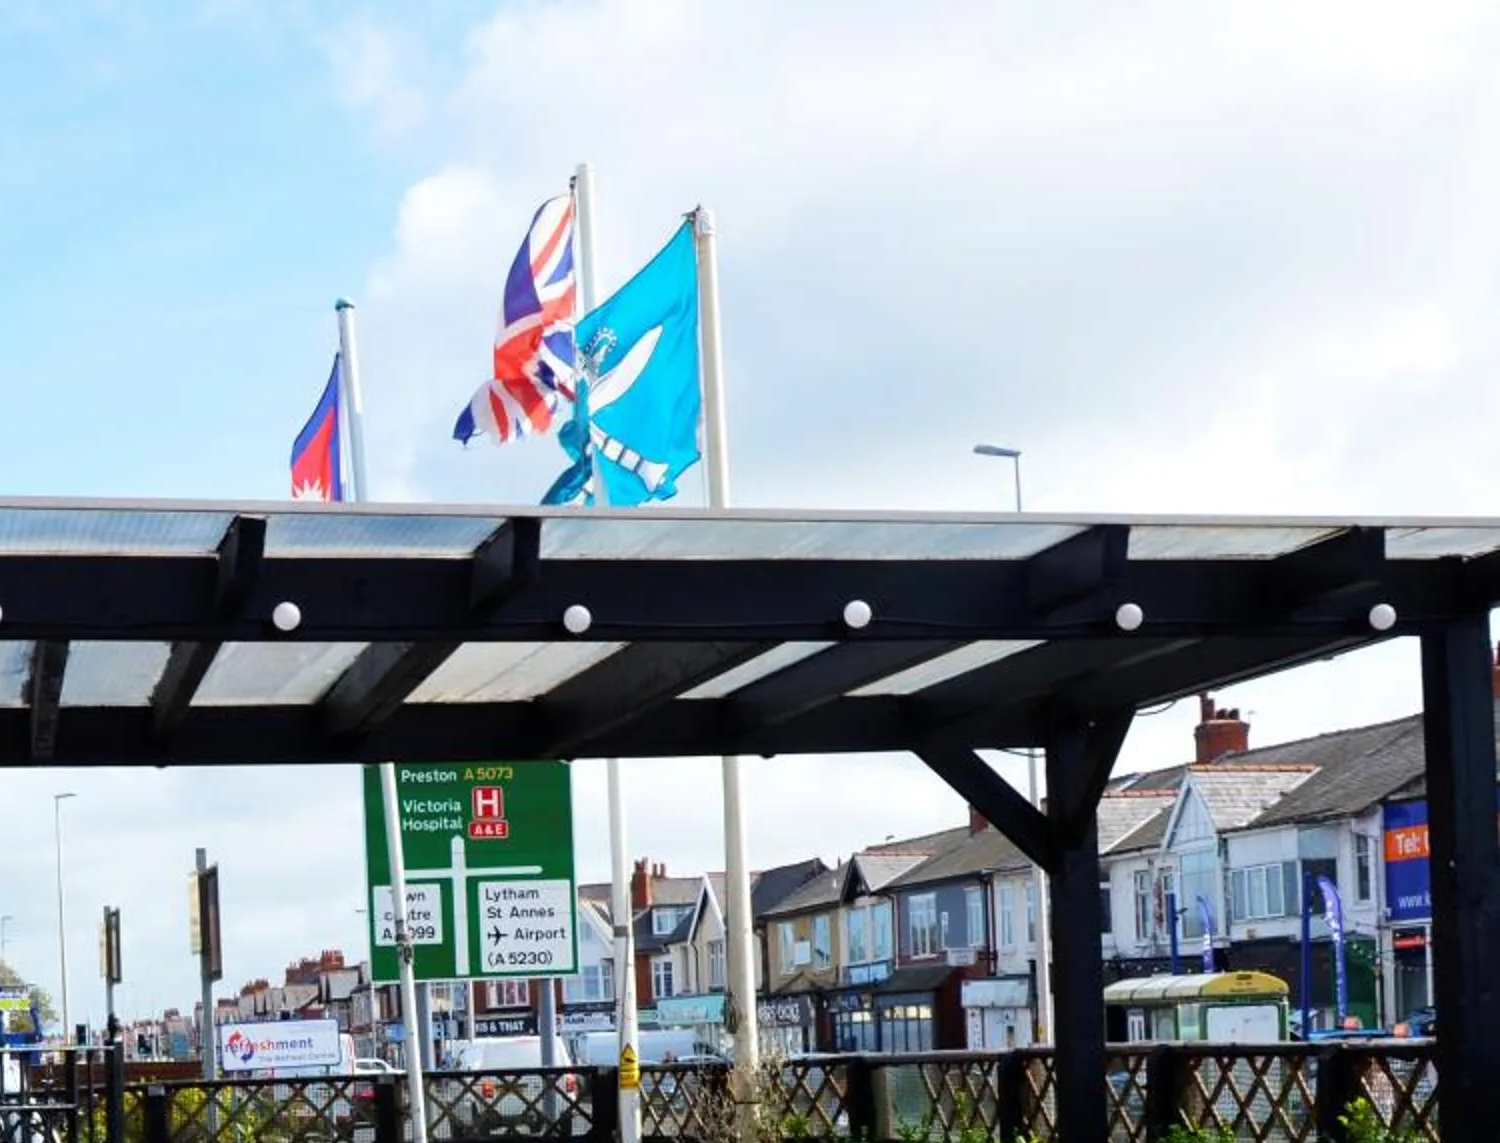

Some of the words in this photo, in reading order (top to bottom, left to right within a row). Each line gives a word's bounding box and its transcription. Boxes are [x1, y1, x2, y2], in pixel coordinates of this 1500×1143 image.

[401, 769, 457, 782] Preston
[403, 799, 462, 813] Victoria
[475, 789, 498, 817] H
[402, 816, 463, 831] Hospital
[1395, 832, 1421, 856] Tel:
[484, 887, 540, 901] Lytham
[383, 908, 431, 920] ctre
[487, 906, 503, 919] St
[509, 905, 555, 919] Annes
[513, 926, 567, 942] Airport
[500, 1020, 526, 1032] THAT
